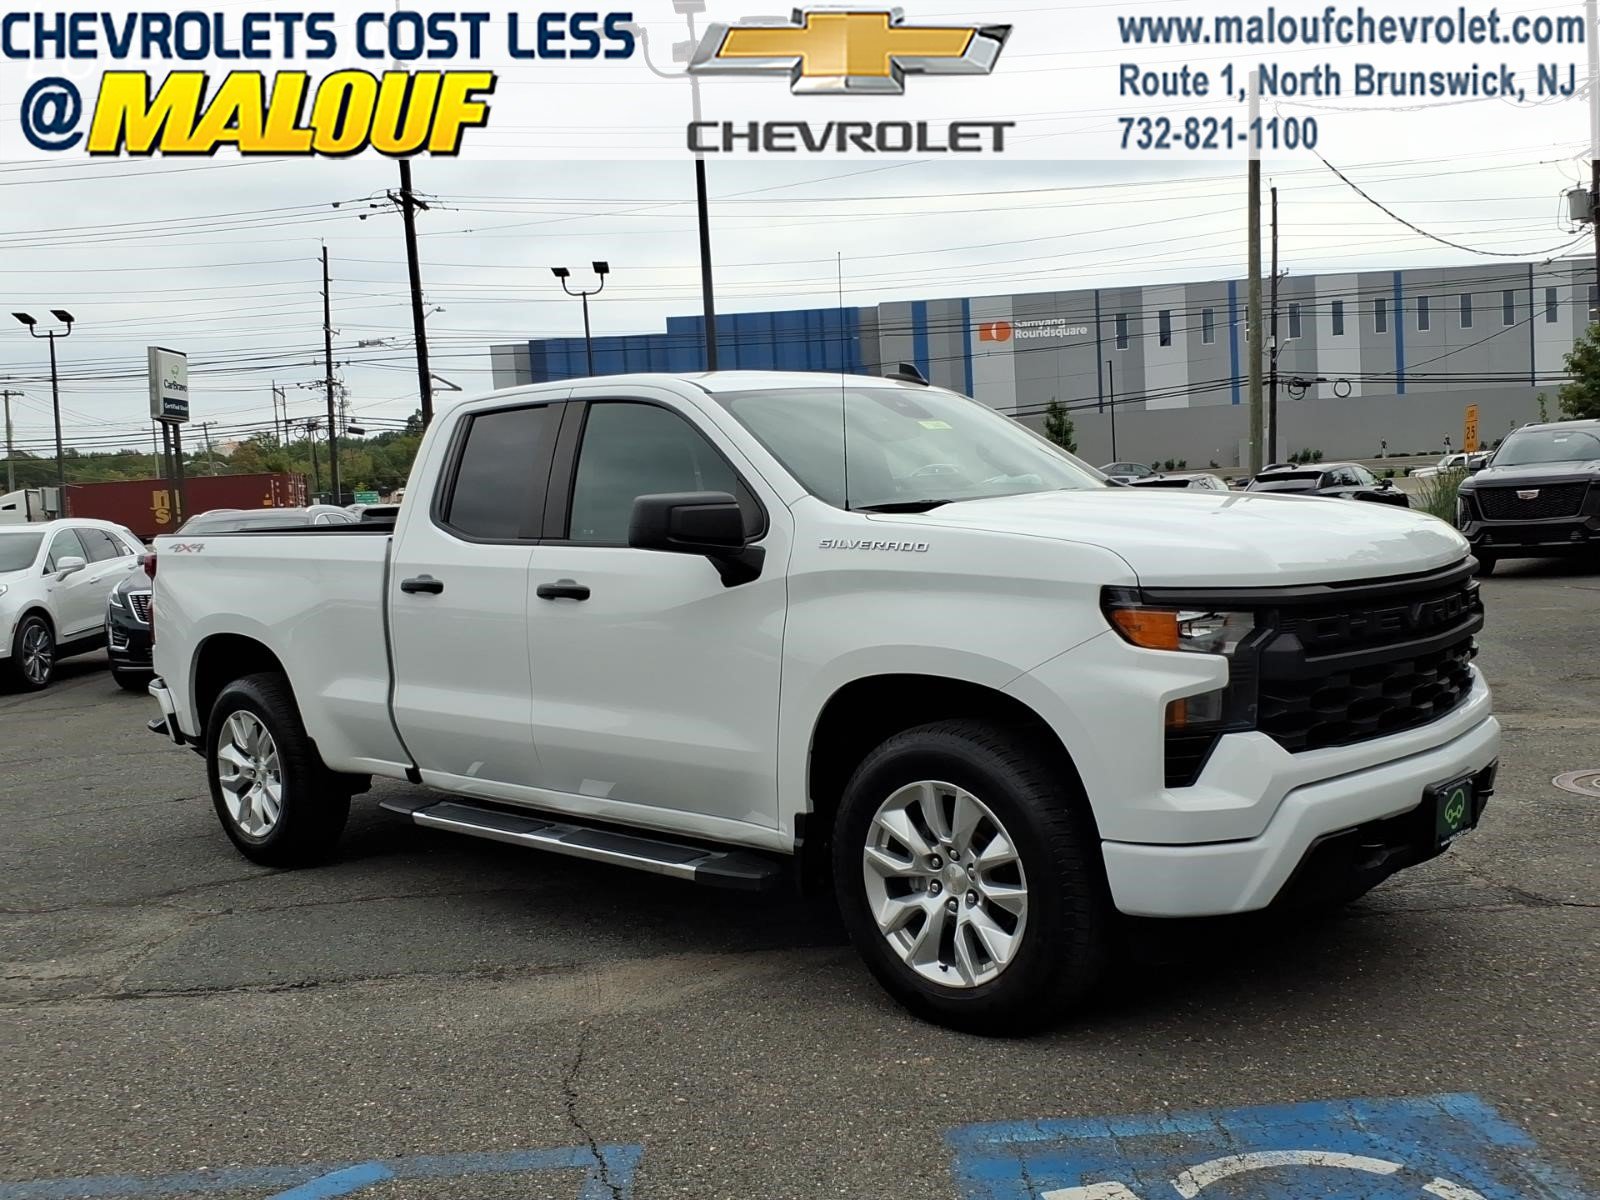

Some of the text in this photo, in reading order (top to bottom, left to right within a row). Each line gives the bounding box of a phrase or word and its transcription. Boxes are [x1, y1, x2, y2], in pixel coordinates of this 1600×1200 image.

[1014, 325, 1088, 339] Roundsquare
[1466, 425, 1476, 440] 25
[818, 538, 930, 553] SILVERADO
